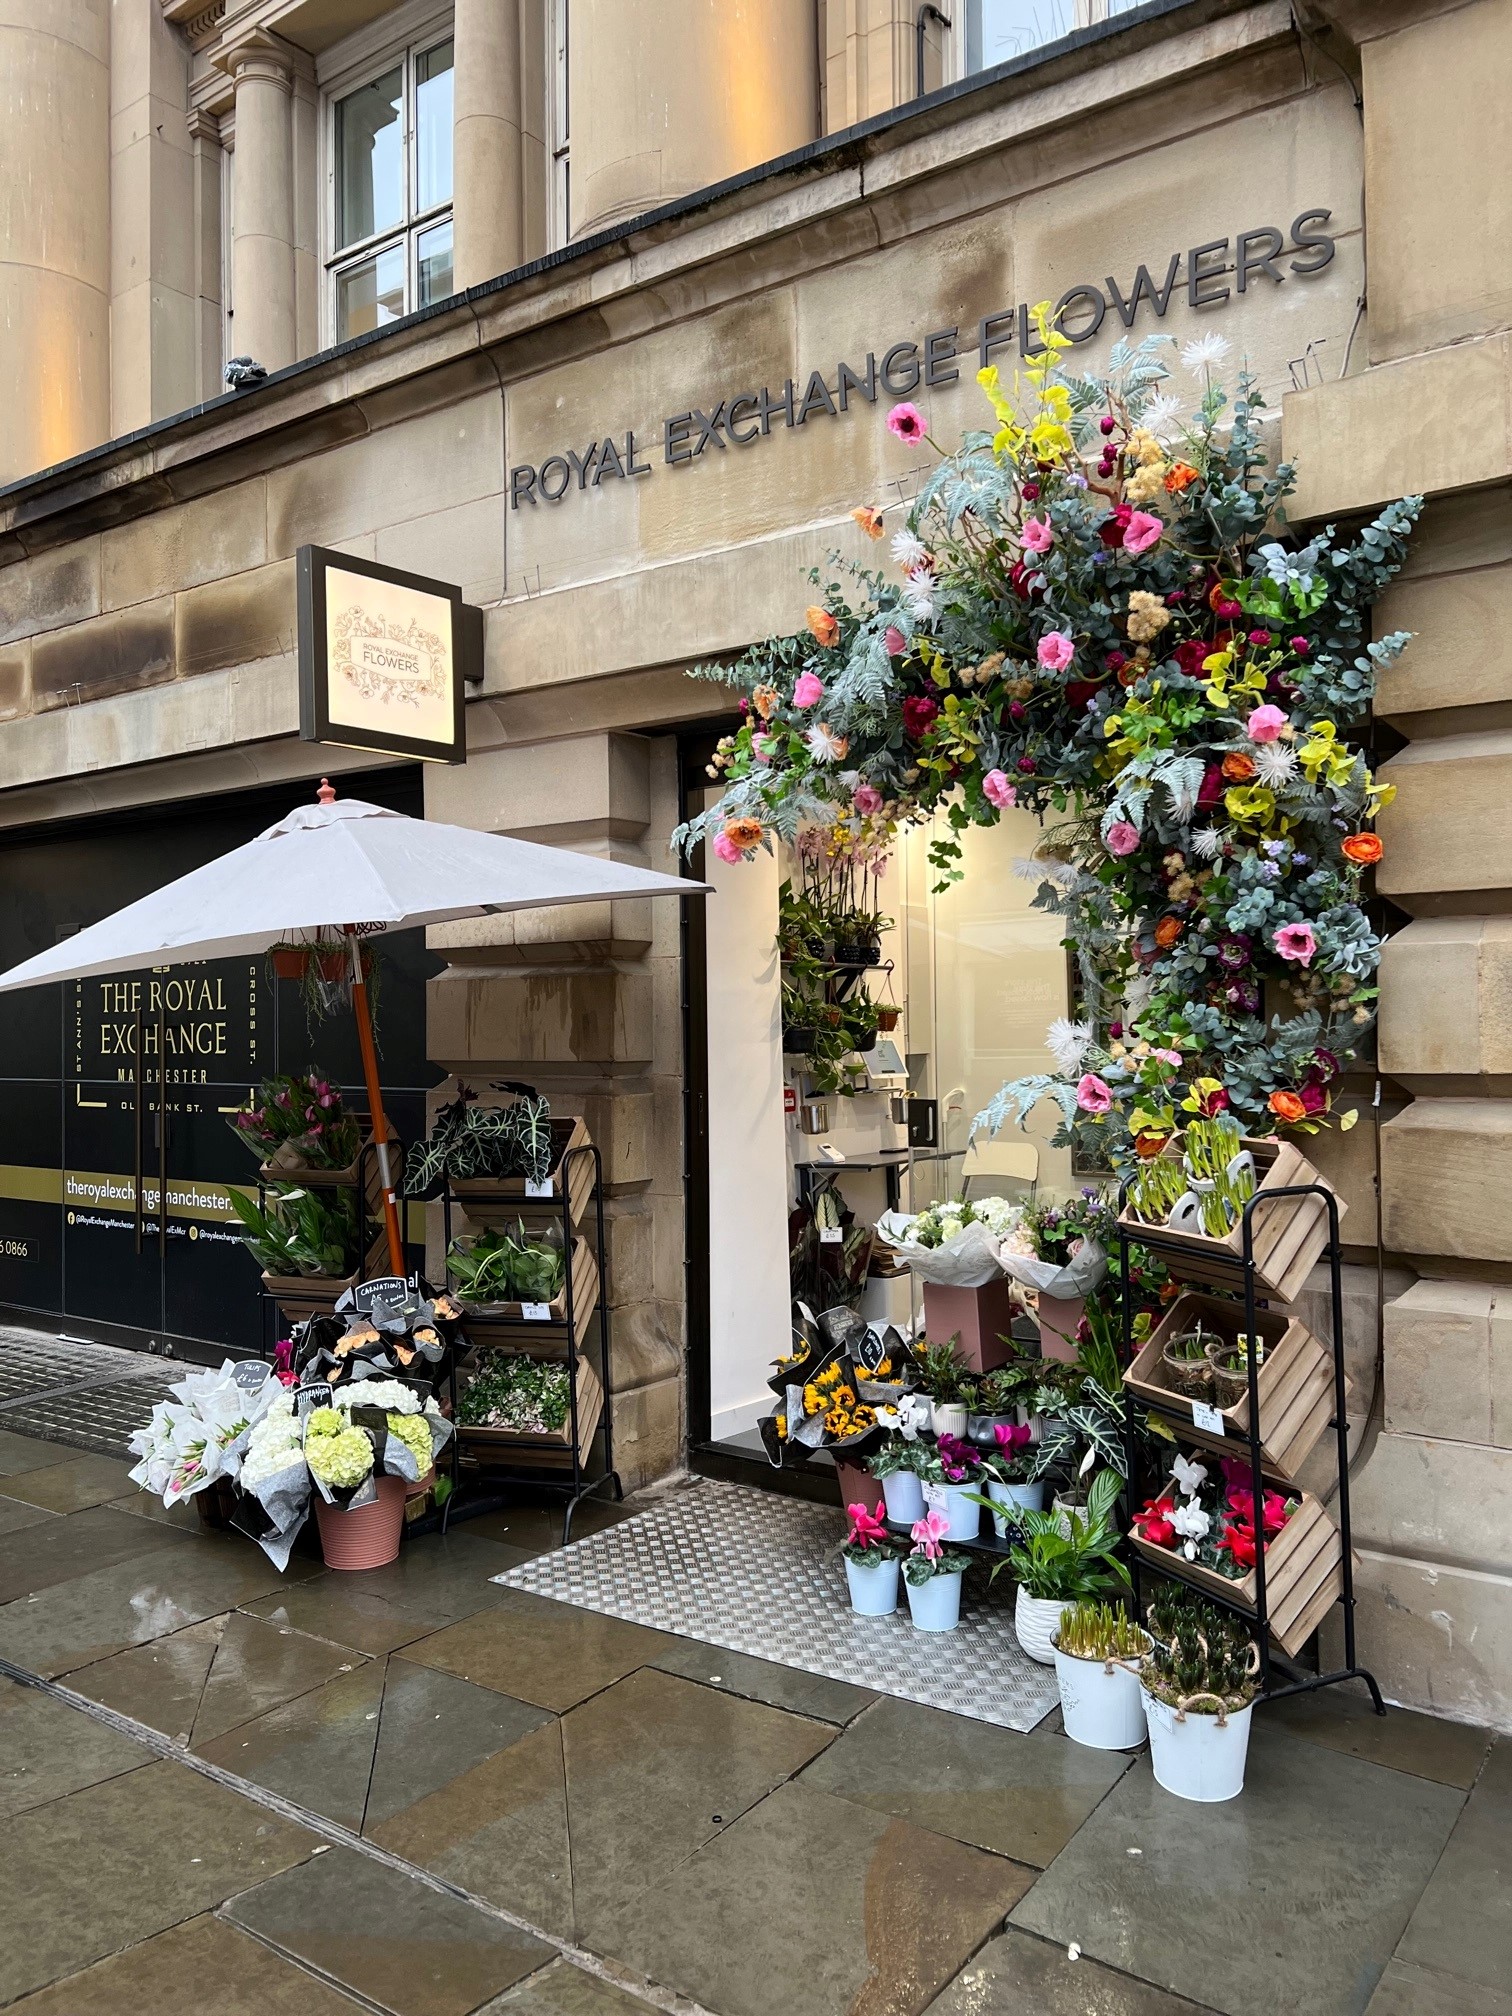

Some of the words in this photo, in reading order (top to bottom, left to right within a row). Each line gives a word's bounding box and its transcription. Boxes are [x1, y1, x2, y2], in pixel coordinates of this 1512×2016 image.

[511, 431, 651, 510] ROYAL
[664, 326, 960, 464] EXCHANGE
[979, 208, 1336, 368] FLOWERS
[363, 643, 384, 653] ROYAL
[385, 647, 419, 661] EXCHANGE
[363, 651, 420, 674] FLOWERS
[100, 982, 141, 1013] THE
[149, 978, 227, 1012] ROYAL
[117, 1068, 207, 1084] MACHESTER
[5, 1240, 28, 1257] 0866
